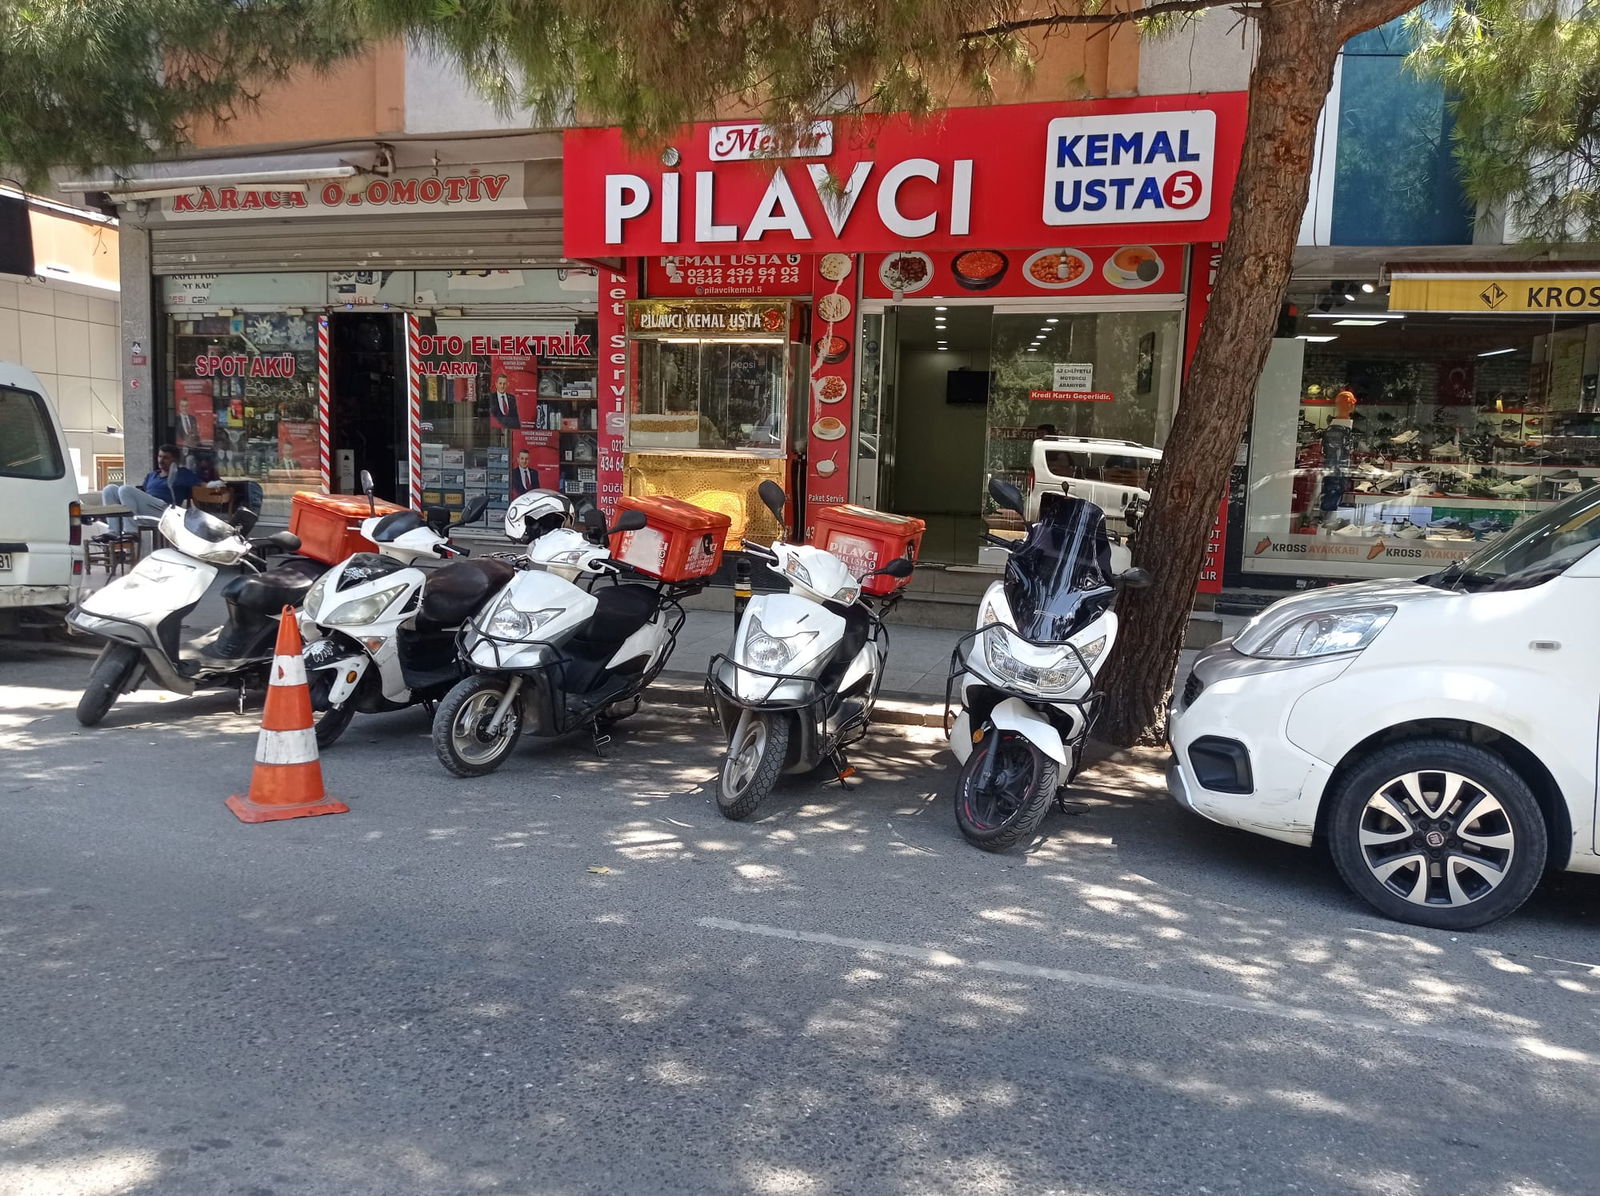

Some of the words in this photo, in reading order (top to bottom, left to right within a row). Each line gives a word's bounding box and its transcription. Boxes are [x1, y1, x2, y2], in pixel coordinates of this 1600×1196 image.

[1056, 129, 1200, 168] KEMAL
[173, 187, 308, 213] KARACA
[1055, 176, 1164, 212] USTA
[1170, 176, 1194, 205] 5
[661, 255, 725, 267] KEMAL
[730, 254, 782, 266] USTA
[687, 268, 723, 277] 0212
[726, 268, 754, 276] 434
[758, 267, 777, 275] 64
[781, 267, 799, 275] 03
[687, 276, 723, 285] 0544
[726, 276, 754, 284] 417
[759, 276, 776, 284] 71
[781, 275, 799, 283] 24
[687, 313, 725, 328] KEMAL
[730, 313, 762, 328] USTA
[418, 335, 464, 356] OTO
[471, 330, 591, 356] ELEKTRİK
[195, 355, 248, 377] SPOT
[250, 352, 295, 378] AKÜ
[417, 361, 478, 376] ALARM
[731, 361, 756, 370] pepsi
[1031, 391, 1051, 399] Kredi
[1072, 392, 1111, 401] Geçerlidir.
[1272, 543, 1307, 553] KROSS
[1308, 545, 1359, 556] AYAKKABI
[1386, 547, 1422, 558] KROSS
